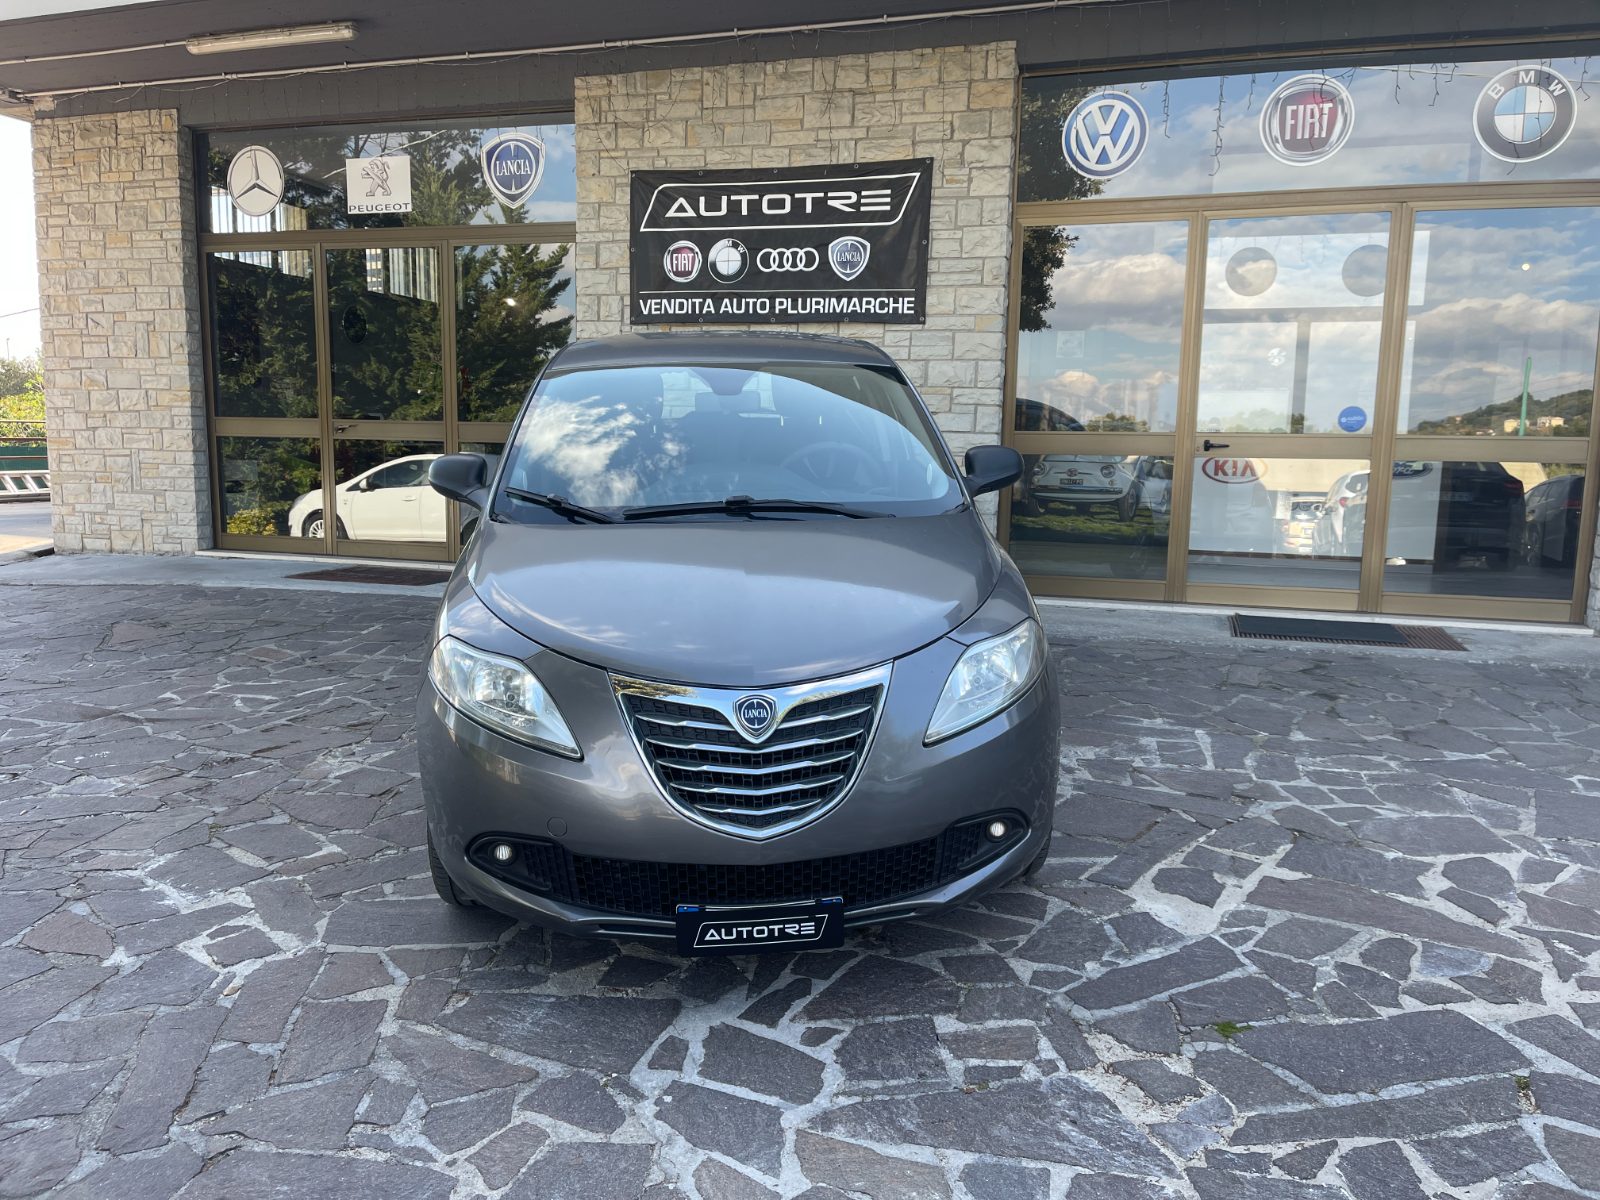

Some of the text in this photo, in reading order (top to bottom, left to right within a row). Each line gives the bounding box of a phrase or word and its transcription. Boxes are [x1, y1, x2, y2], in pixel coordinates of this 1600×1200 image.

[1487, 70, 1566, 99] BMW
[1284, 103, 1334, 140] FIAT
[496, 159, 531, 176] LANCIA
[348, 202, 410, 213] PEUGEOT
[665, 189, 892, 218] AUTOTRE
[672, 253, 694, 272] FIAT
[837, 251, 861, 262] LANCIA
[639, 297, 915, 315] VENDITA AUTO PLURIMARCHE
[1213, 459, 1256, 477] KIA
[744, 708, 767, 718] LANCIA
[704, 922, 815, 941] AUTOTRE
